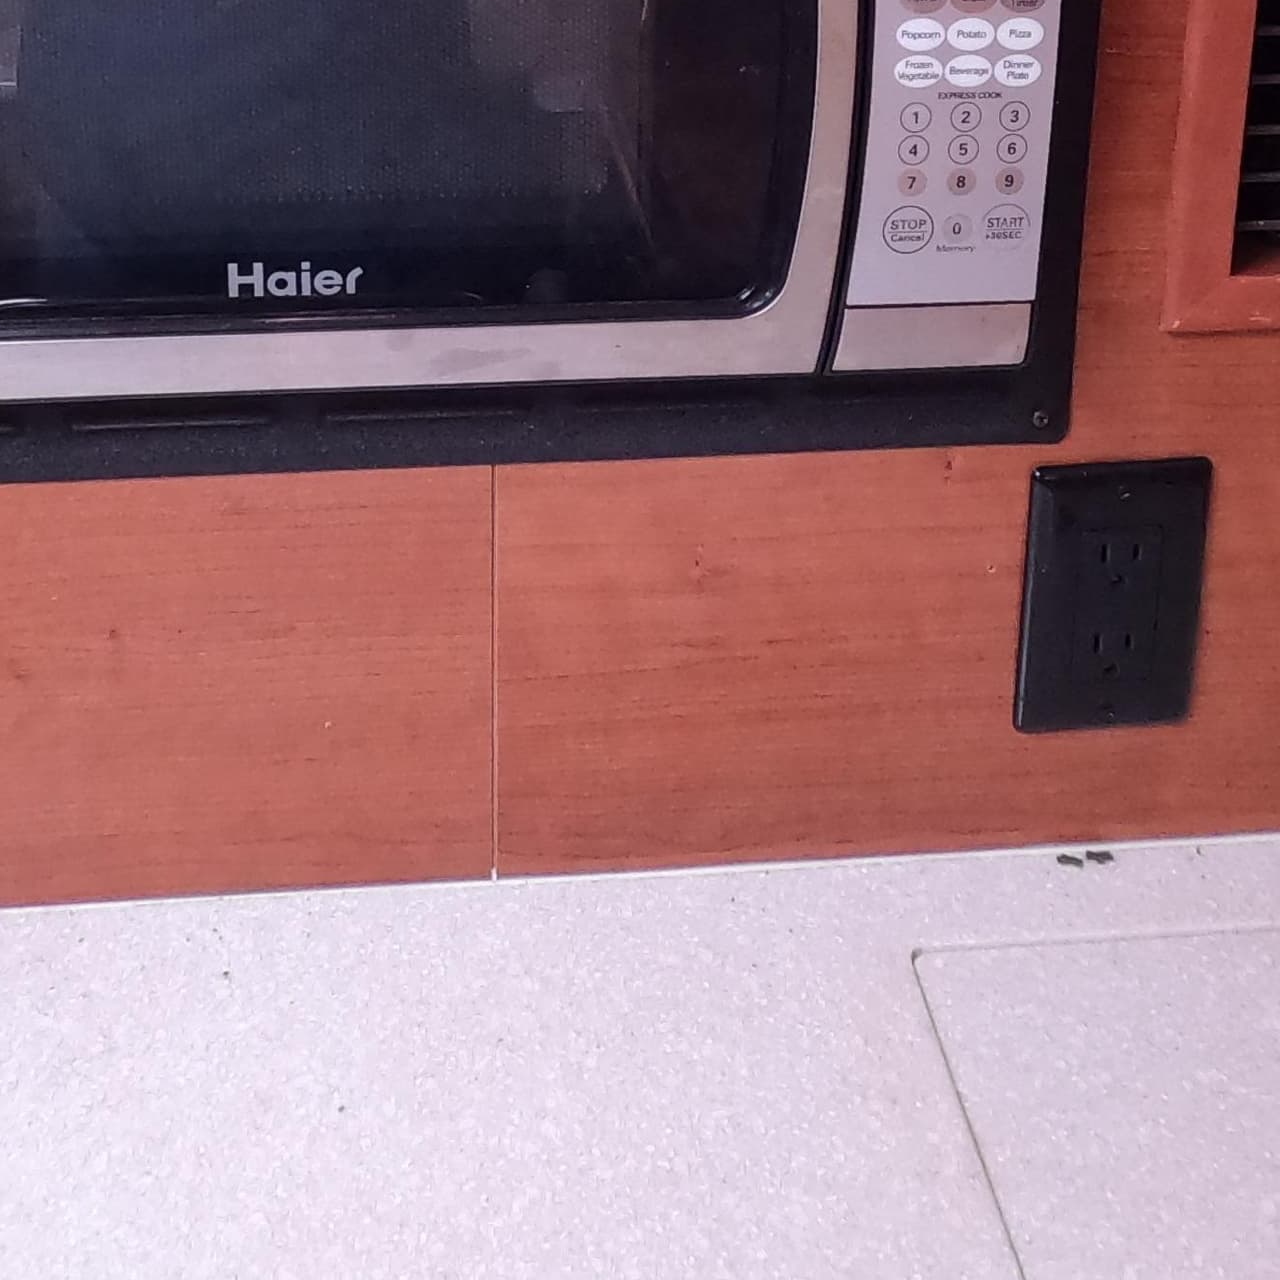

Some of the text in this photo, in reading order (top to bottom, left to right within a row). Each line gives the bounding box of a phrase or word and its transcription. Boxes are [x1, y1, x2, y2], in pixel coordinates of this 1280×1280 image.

[901, 30, 941, 41] Popcorn
[956, 29, 987, 39] Potato
[1008, 28, 1032, 39] Pizza
[904, 60, 934, 70] Frozen
[1003, 60, 1034, 70] Dinner
[897, 72, 940, 82] Vegetable
[949, 66, 989, 77] Beverage
[1006, 71, 1029, 81] Plate
[937, 91, 1003, 100] EXPRESS COOK
[912, 111, 919, 124] 1
[961, 110, 971, 124] 2
[1009, 109, 1020, 123] 3
[908, 143, 918, 157] 4
[959, 142, 969, 156] 5
[1007, 142, 1017, 155] 6
[907, 176, 917, 189] 7
[956, 175, 966, 189] 8
[1004, 174, 1015, 188] 9
[890, 220, 927, 230] STOP
[987, 217, 1024, 228] START
[952, 222, 962, 235] 0
[890, 232, 925, 242] Cancel
[227, 261, 364, 298] Haier
